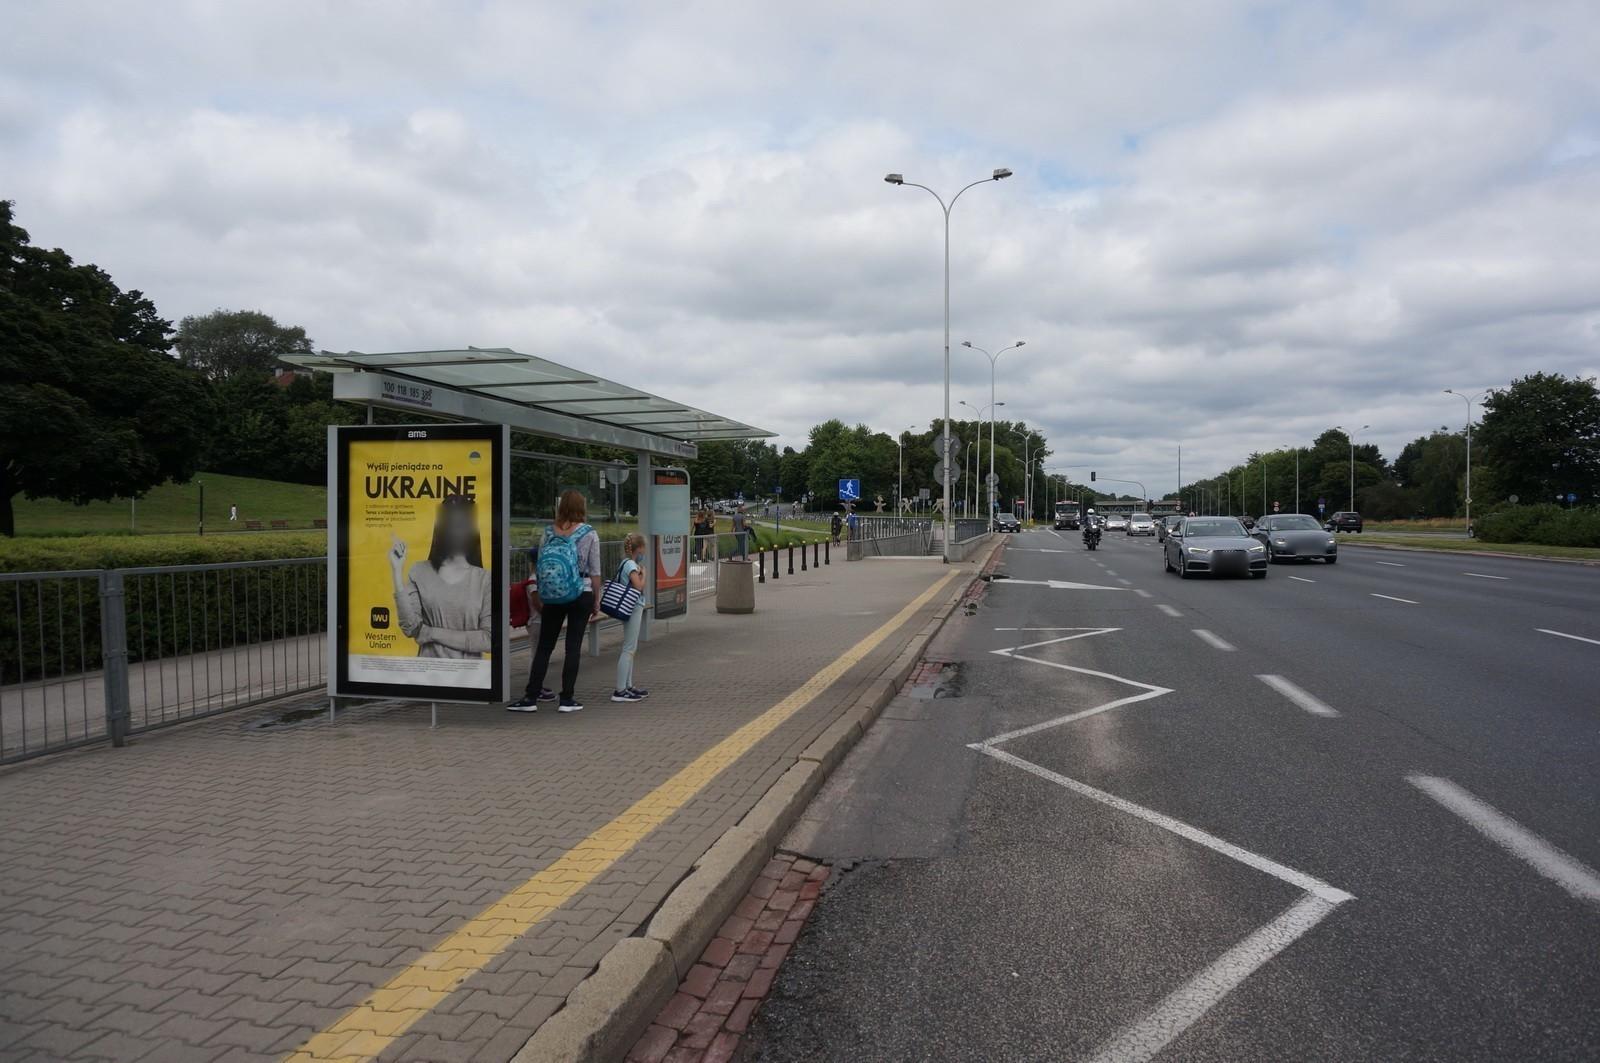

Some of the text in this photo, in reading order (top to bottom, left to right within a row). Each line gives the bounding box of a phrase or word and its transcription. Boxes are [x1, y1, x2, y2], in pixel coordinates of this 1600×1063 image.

[408, 430, 427, 438] ams
[366, 462, 443, 473] Wyślij pieniądze na
[365, 632, 397, 641] Western
[369, 640, 392, 649] Union
